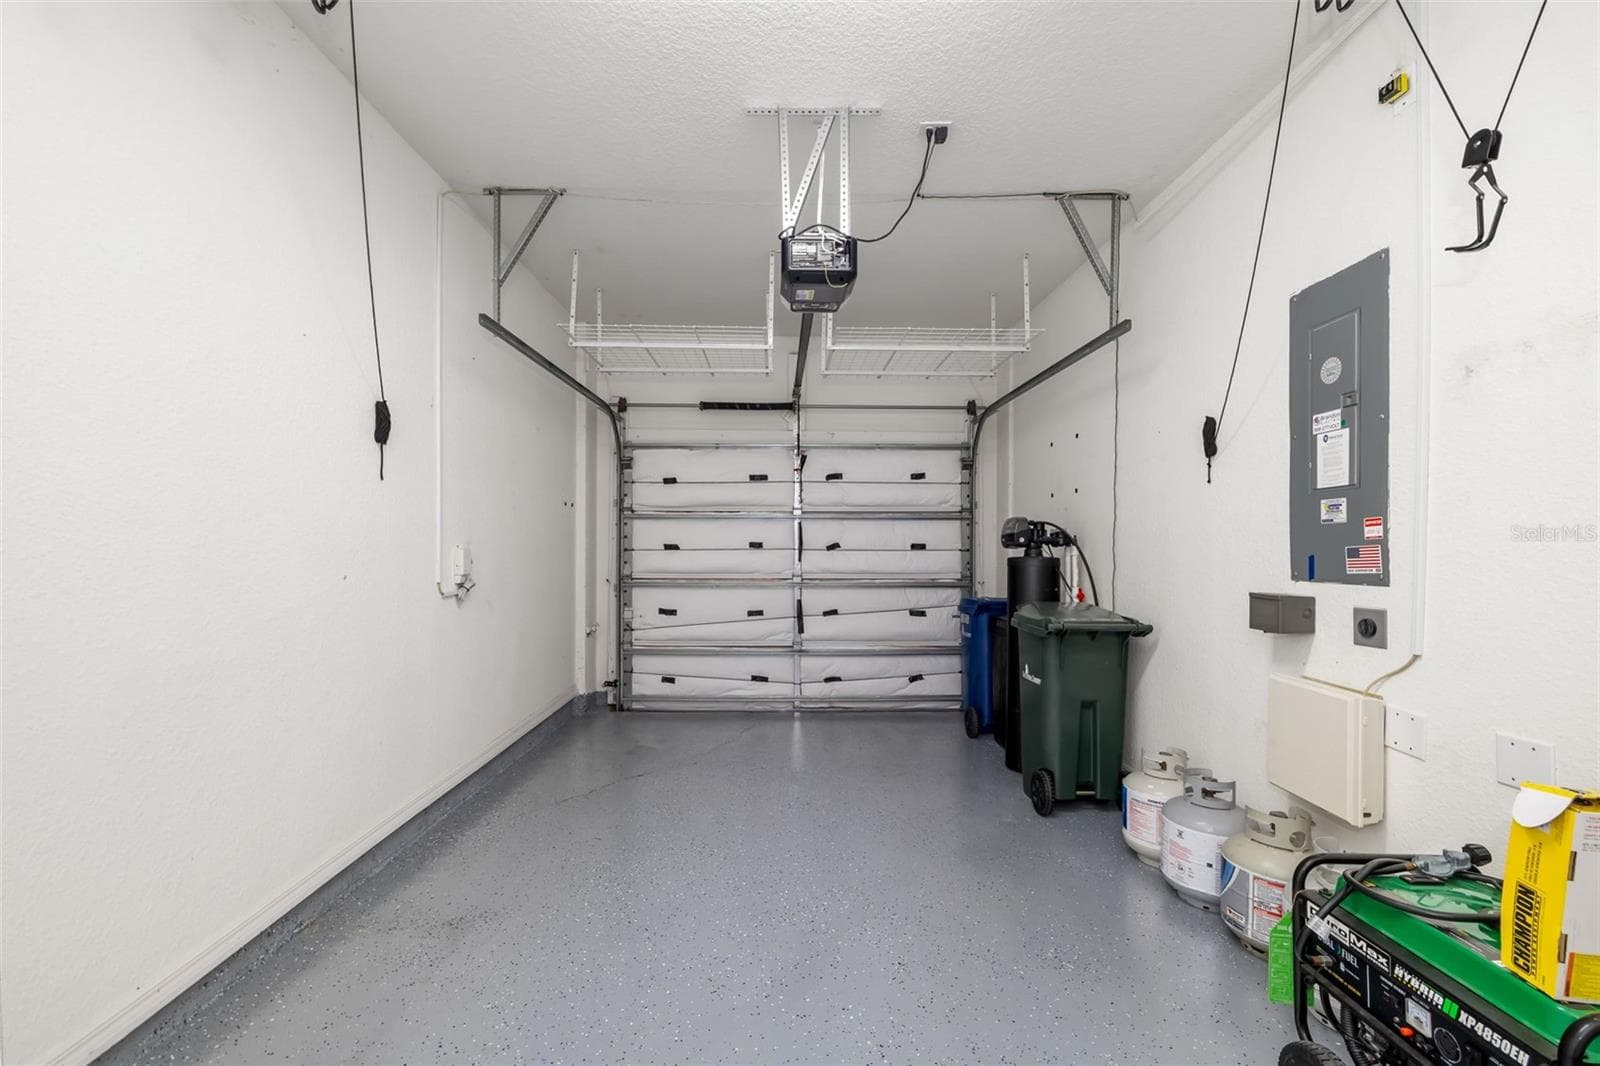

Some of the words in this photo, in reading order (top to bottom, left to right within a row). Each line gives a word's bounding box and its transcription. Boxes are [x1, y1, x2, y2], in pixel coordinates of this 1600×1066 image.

[1309, 903, 1389, 969] roMax
[1513, 883, 1536, 974] CHAMPION
[1341, 947, 1359, 969] FUEL
[1393, 963, 1445, 1010] HYBRID
[1457, 1008, 1531, 1066] XP4850EH
